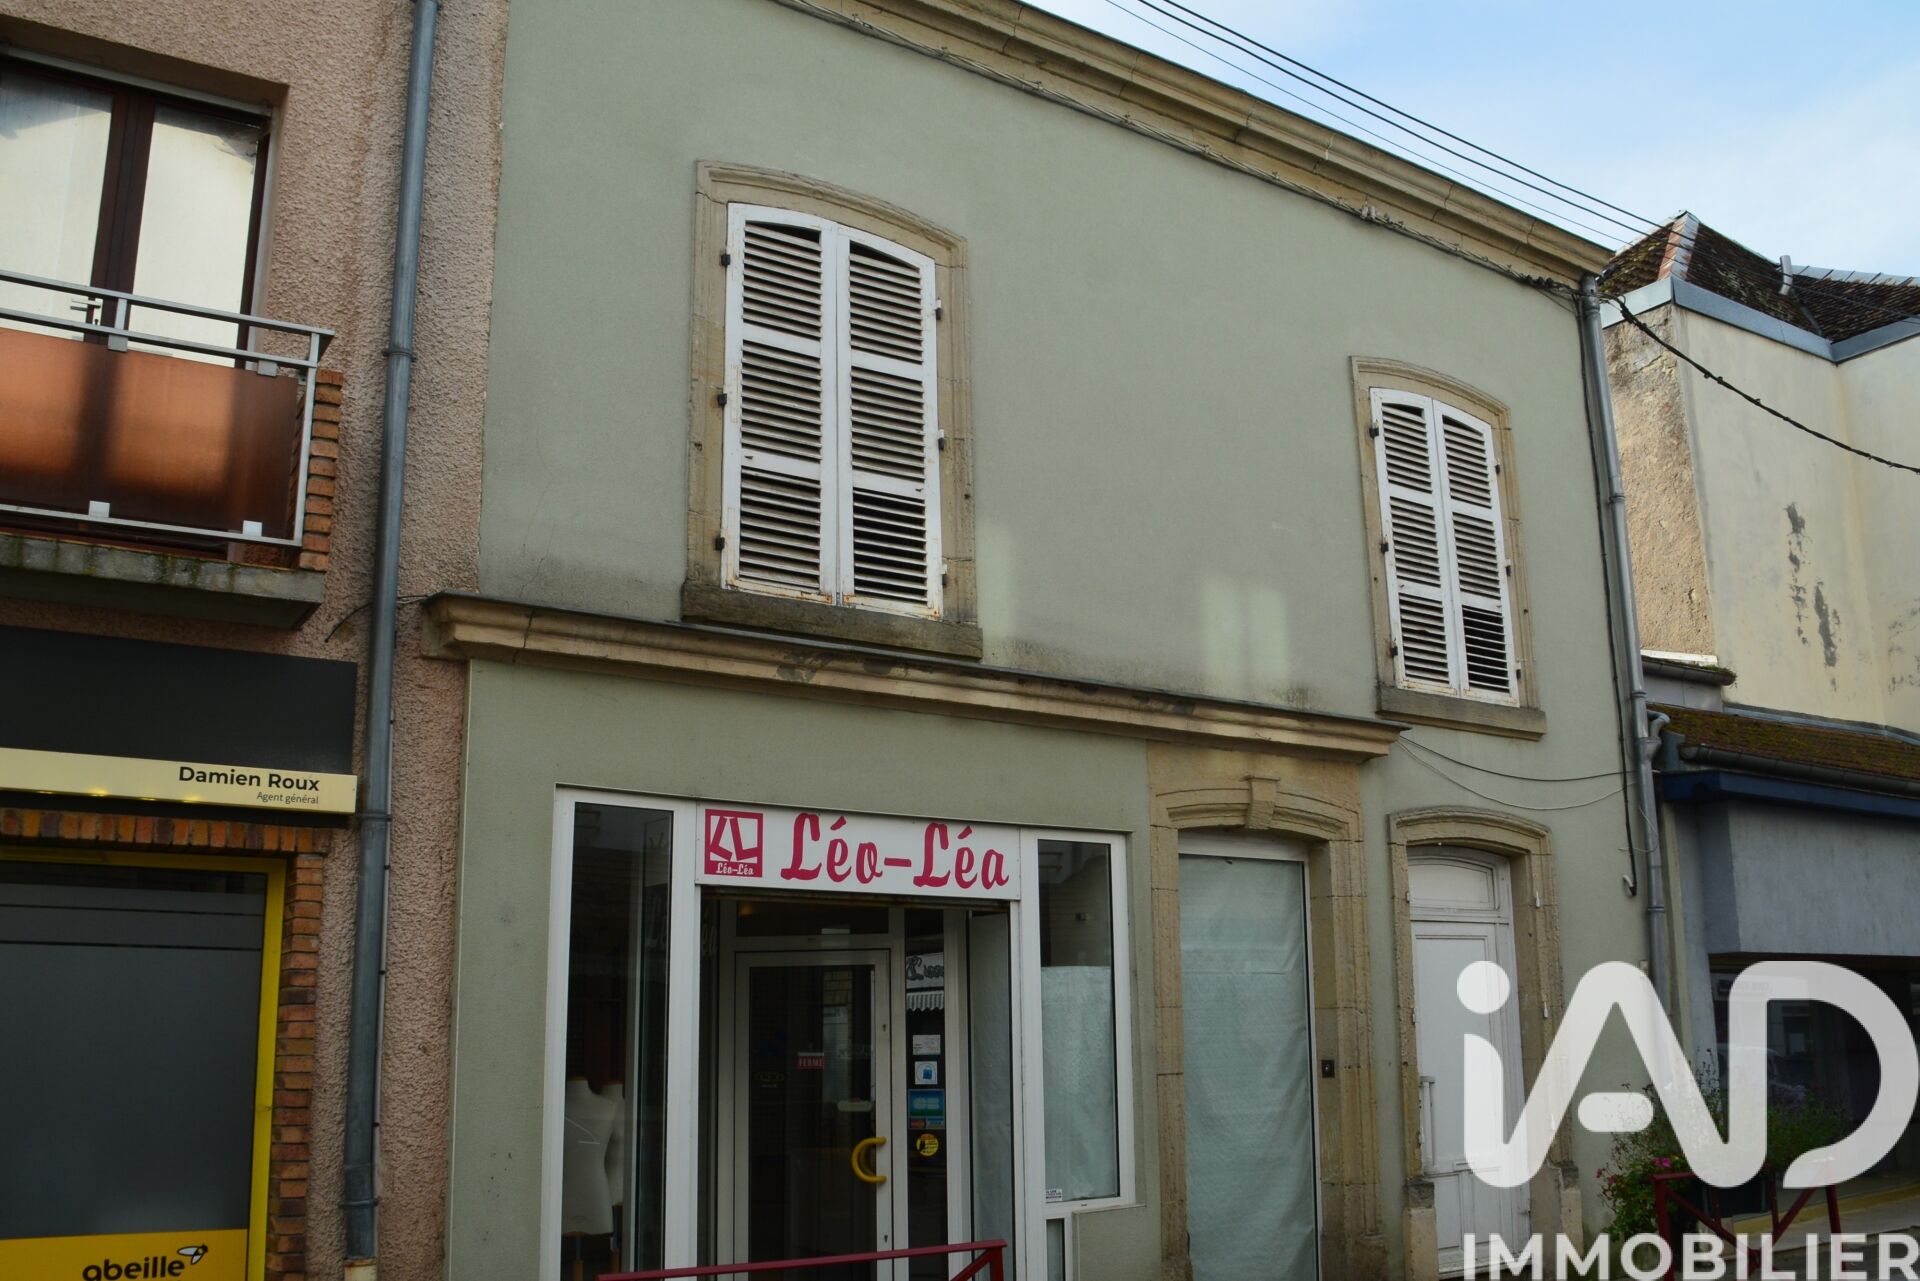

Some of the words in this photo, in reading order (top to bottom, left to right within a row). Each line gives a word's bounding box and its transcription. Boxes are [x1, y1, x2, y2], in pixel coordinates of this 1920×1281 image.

[179, 766, 261, 786] Damien
[268, 773, 320, 791] Roux
[257, 792, 283, 803] Agent
[285, 793, 319, 805] général
[780, 812, 1009, 889] Léo-Léa
[716, 862, 754, 875] Léo-Léa
[82, 1256, 186, 1281] abeille
